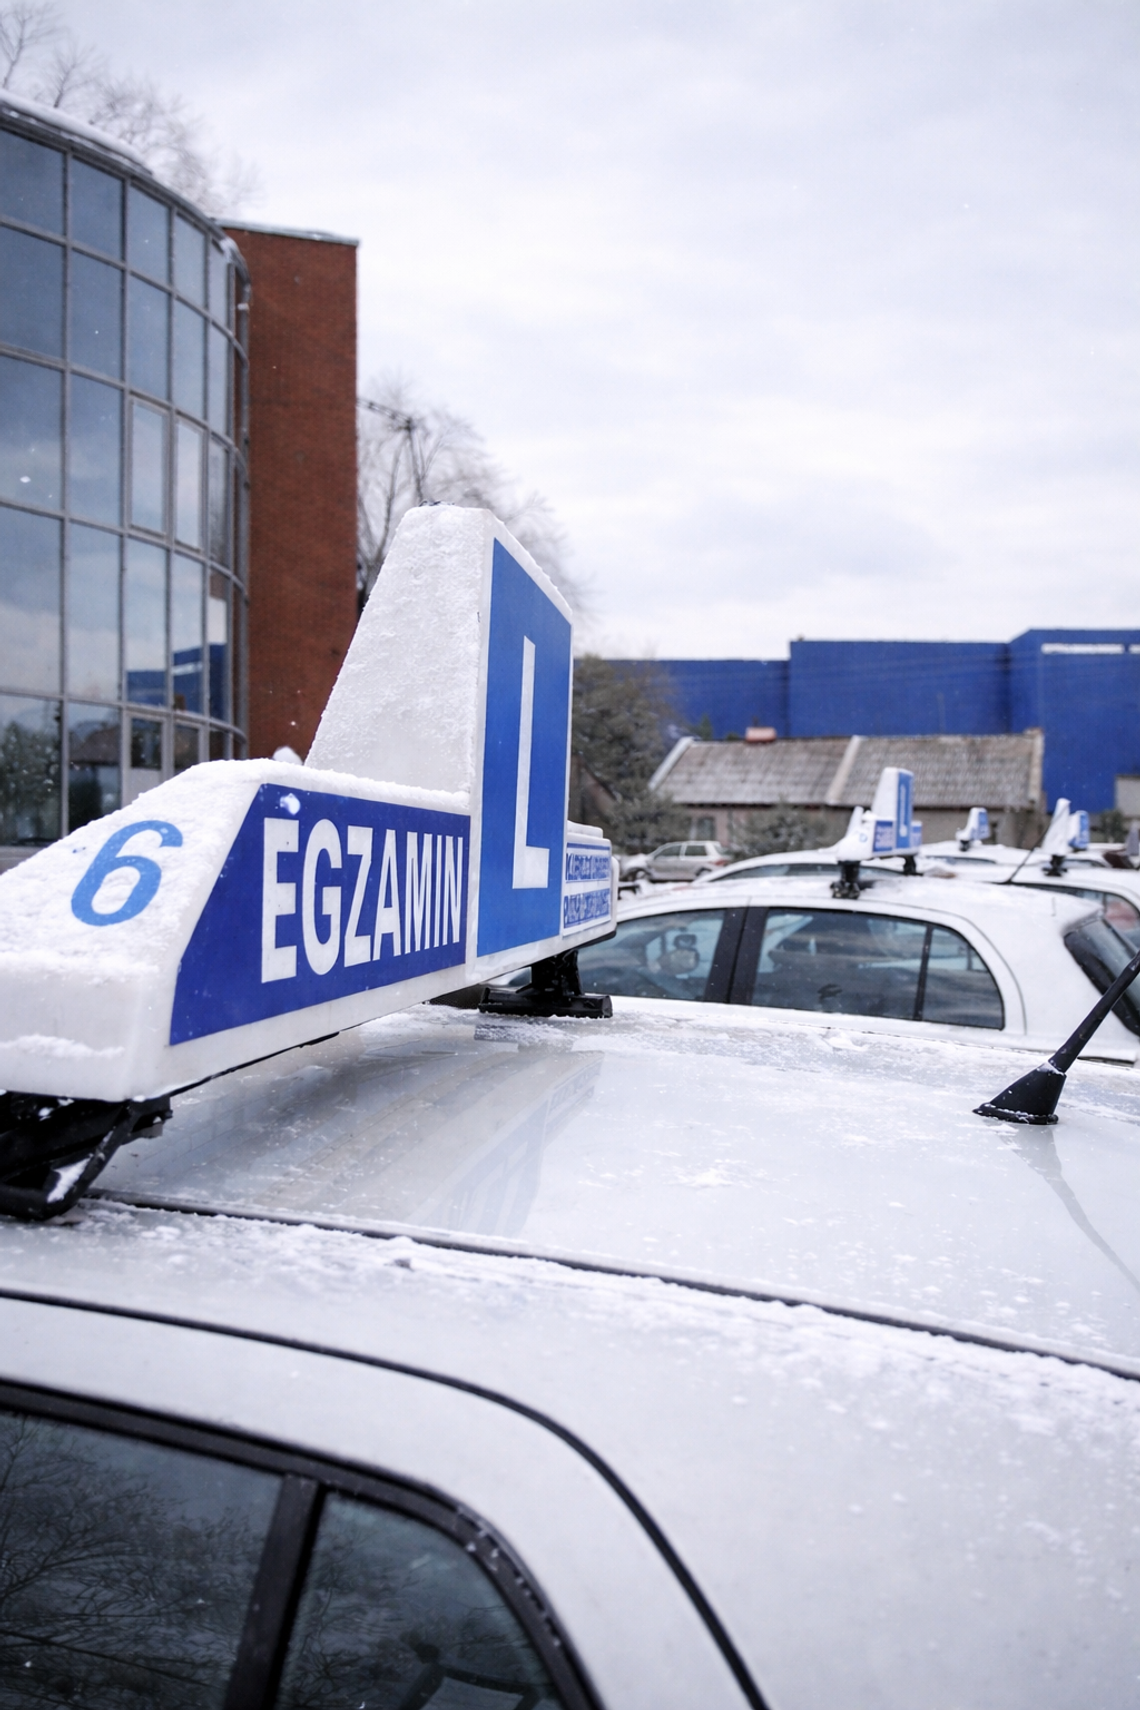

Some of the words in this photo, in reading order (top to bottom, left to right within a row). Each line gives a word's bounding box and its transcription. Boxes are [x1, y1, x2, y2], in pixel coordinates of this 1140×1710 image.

[512, 635, 549, 889] L
[71, 820, 183, 926] 6
[261, 817, 463, 984] EGZAMIN
